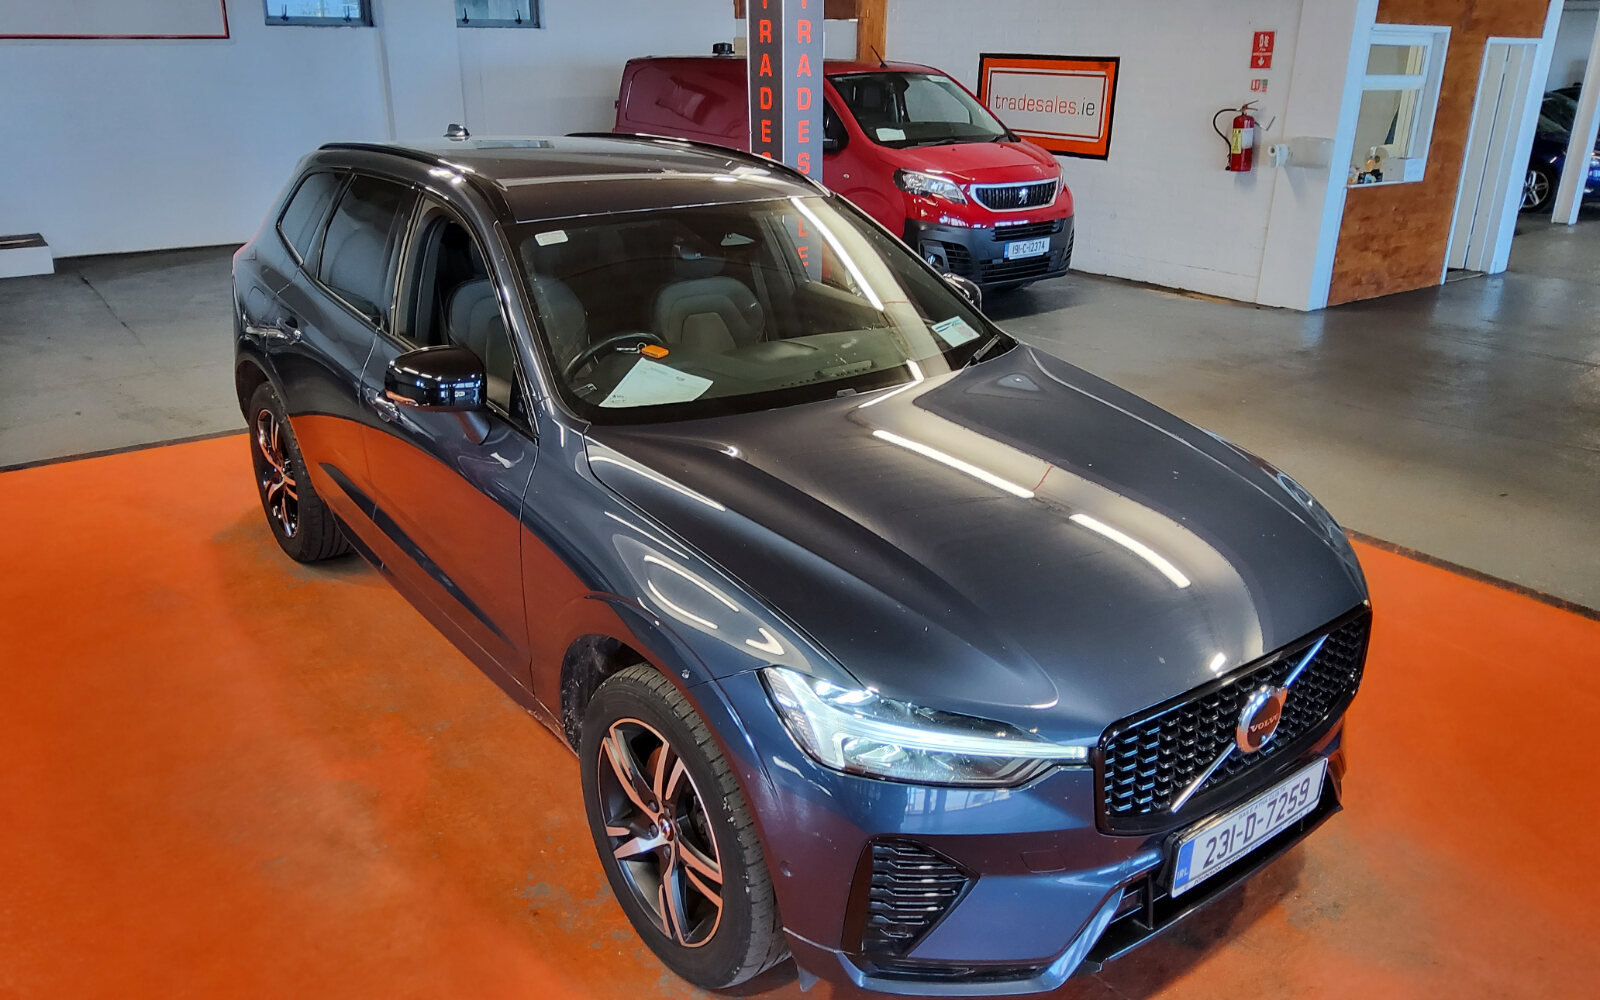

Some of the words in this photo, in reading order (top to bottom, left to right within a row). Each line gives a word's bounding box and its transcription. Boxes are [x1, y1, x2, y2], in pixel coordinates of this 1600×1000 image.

[759, 0, 772, 158] RADE
[995, 93, 1095, 116] tradesales.ie
[1012, 241, 1045, 254] 191-C-12374
[1203, 777, 1310, 869] 231-D-7259
[1177, 867, 1188, 881] IRL
